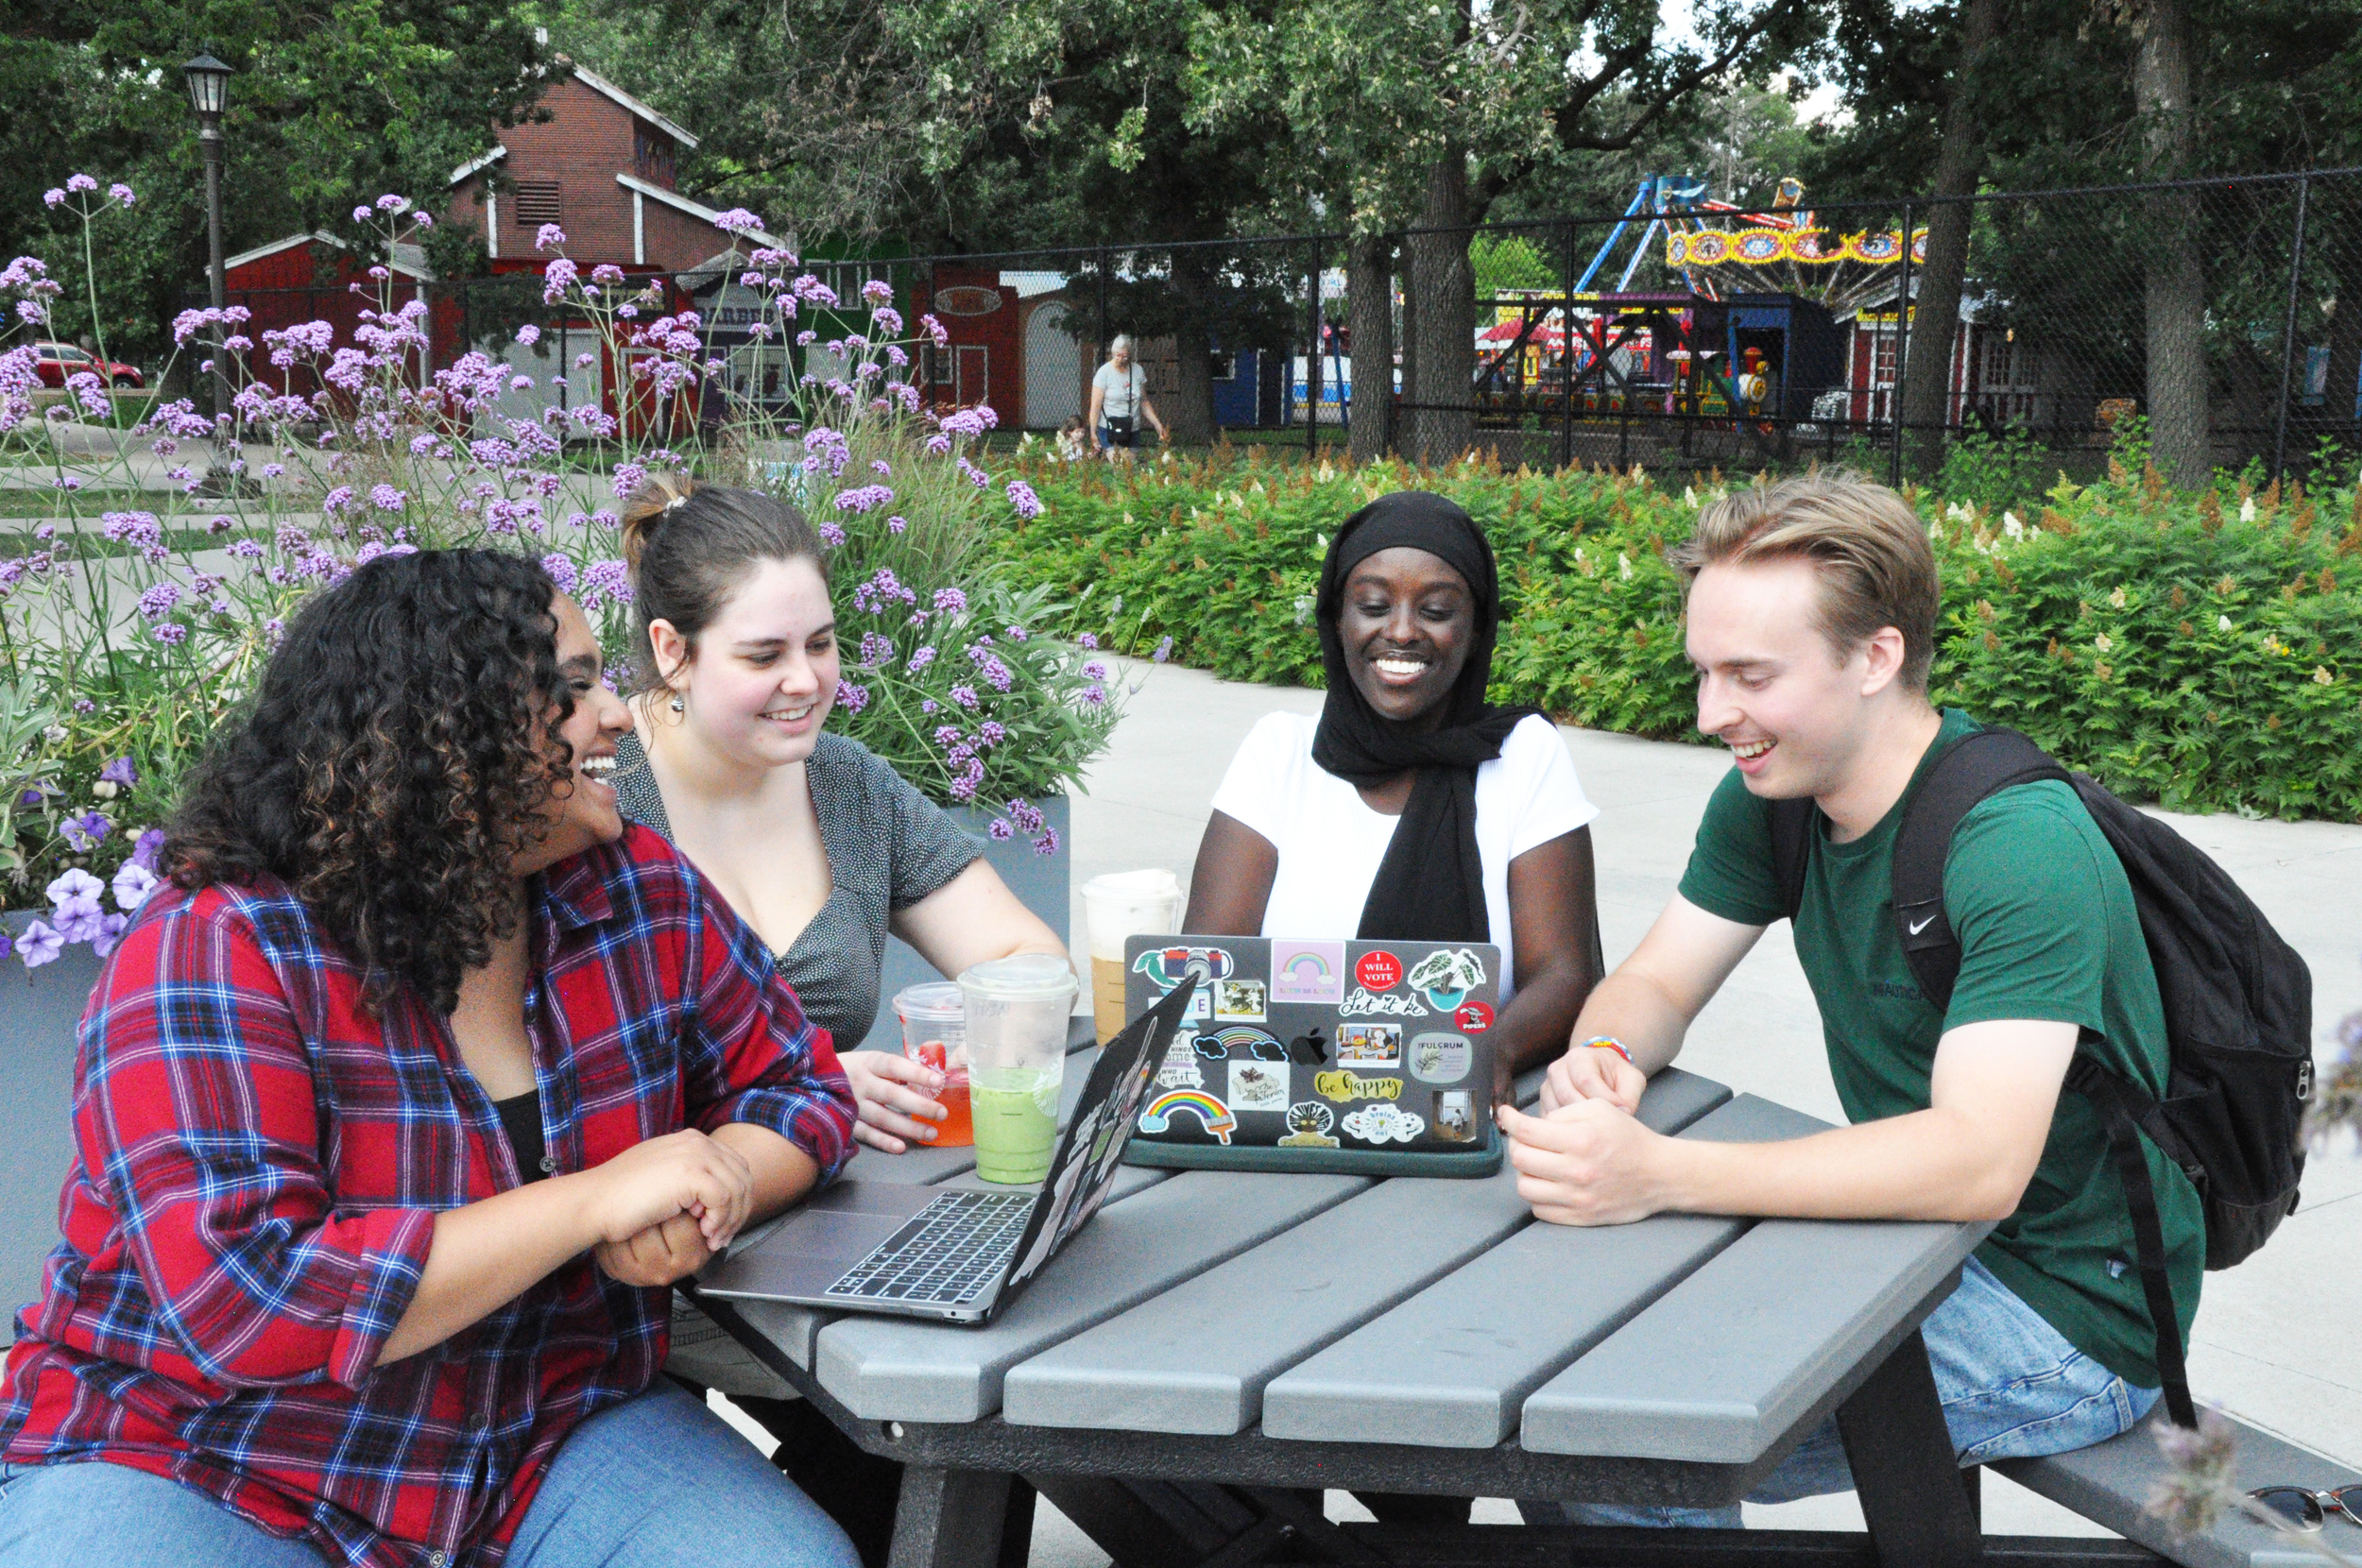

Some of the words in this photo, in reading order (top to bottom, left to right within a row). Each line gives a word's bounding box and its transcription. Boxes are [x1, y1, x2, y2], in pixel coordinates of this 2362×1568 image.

[1364, 973, 1394, 981] VOTE
[1341, 988, 1376, 1014] Let
[1381, 997, 1398, 1013] it
[1166, 1052, 1190, 1062] ome
[1158, 1070, 1198, 1084] wait
[1317, 1073, 1339, 1094] be
[1343, 1072, 1398, 1099] happy
